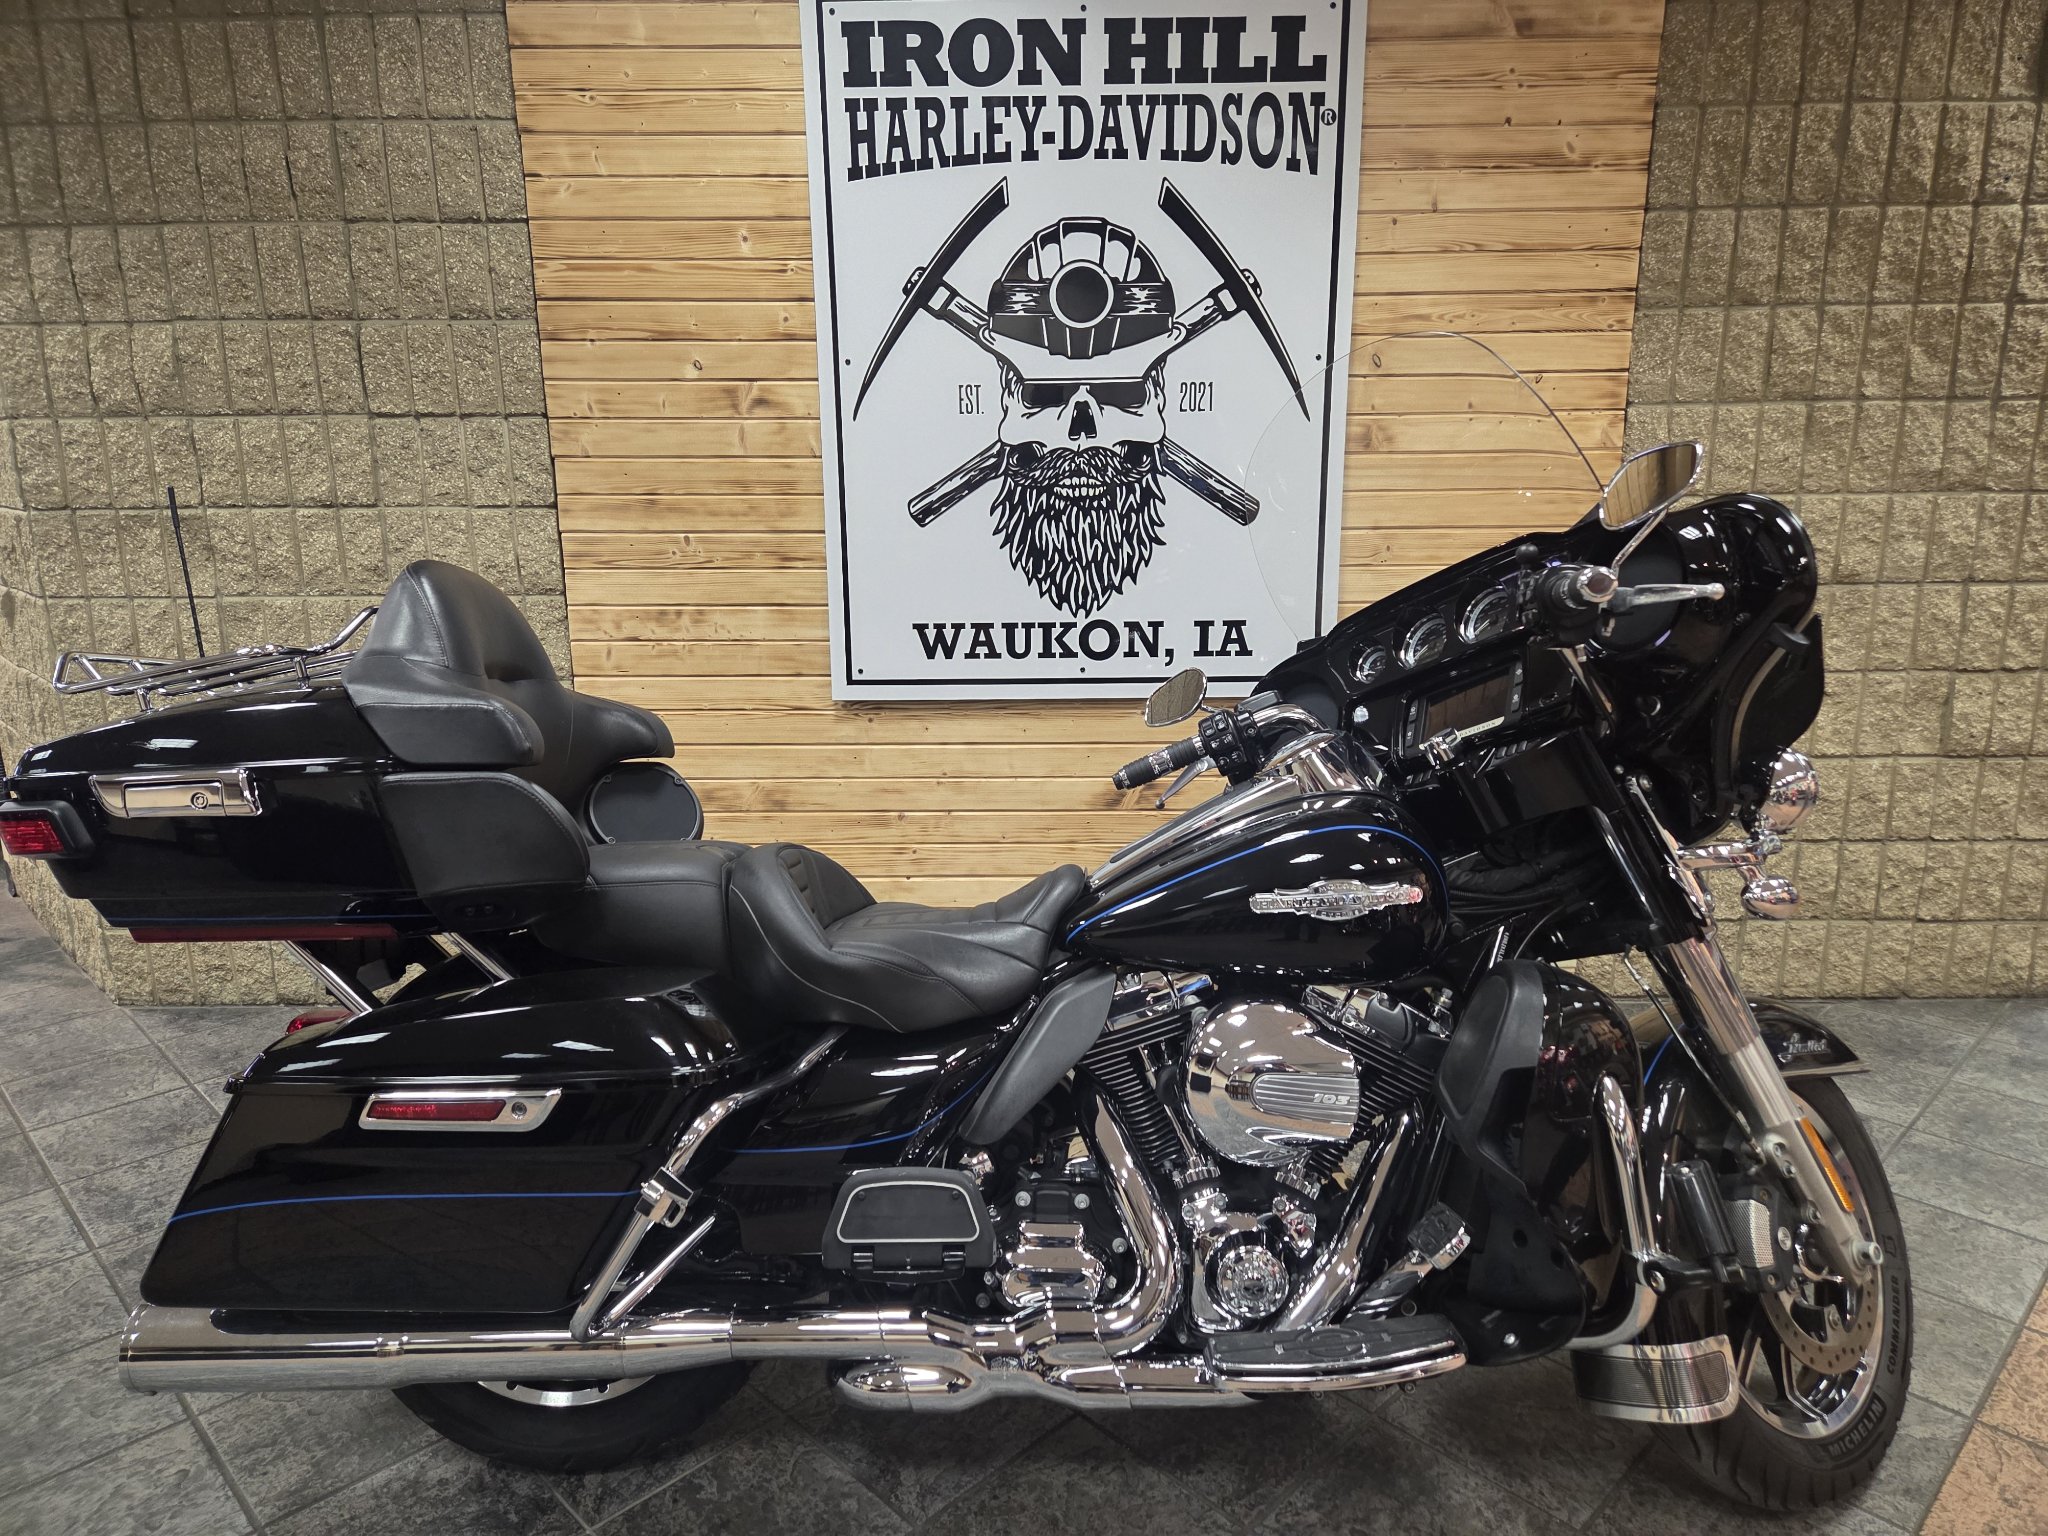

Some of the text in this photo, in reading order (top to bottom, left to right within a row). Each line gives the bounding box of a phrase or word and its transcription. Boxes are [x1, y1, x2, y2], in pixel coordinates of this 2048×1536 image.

[841, 15, 1328, 88] IRON HILL
[958, 384, 985, 415] EST.
[1179, 381, 1214, 413] 2021
[912, 619, 1253, 667] WAUKON, IA
[1313, 1093, 1350, 1105] 103
[1886, 1275, 1900, 1375] COMMANDER
[1828, 1399, 1884, 1457] MICHELIN
